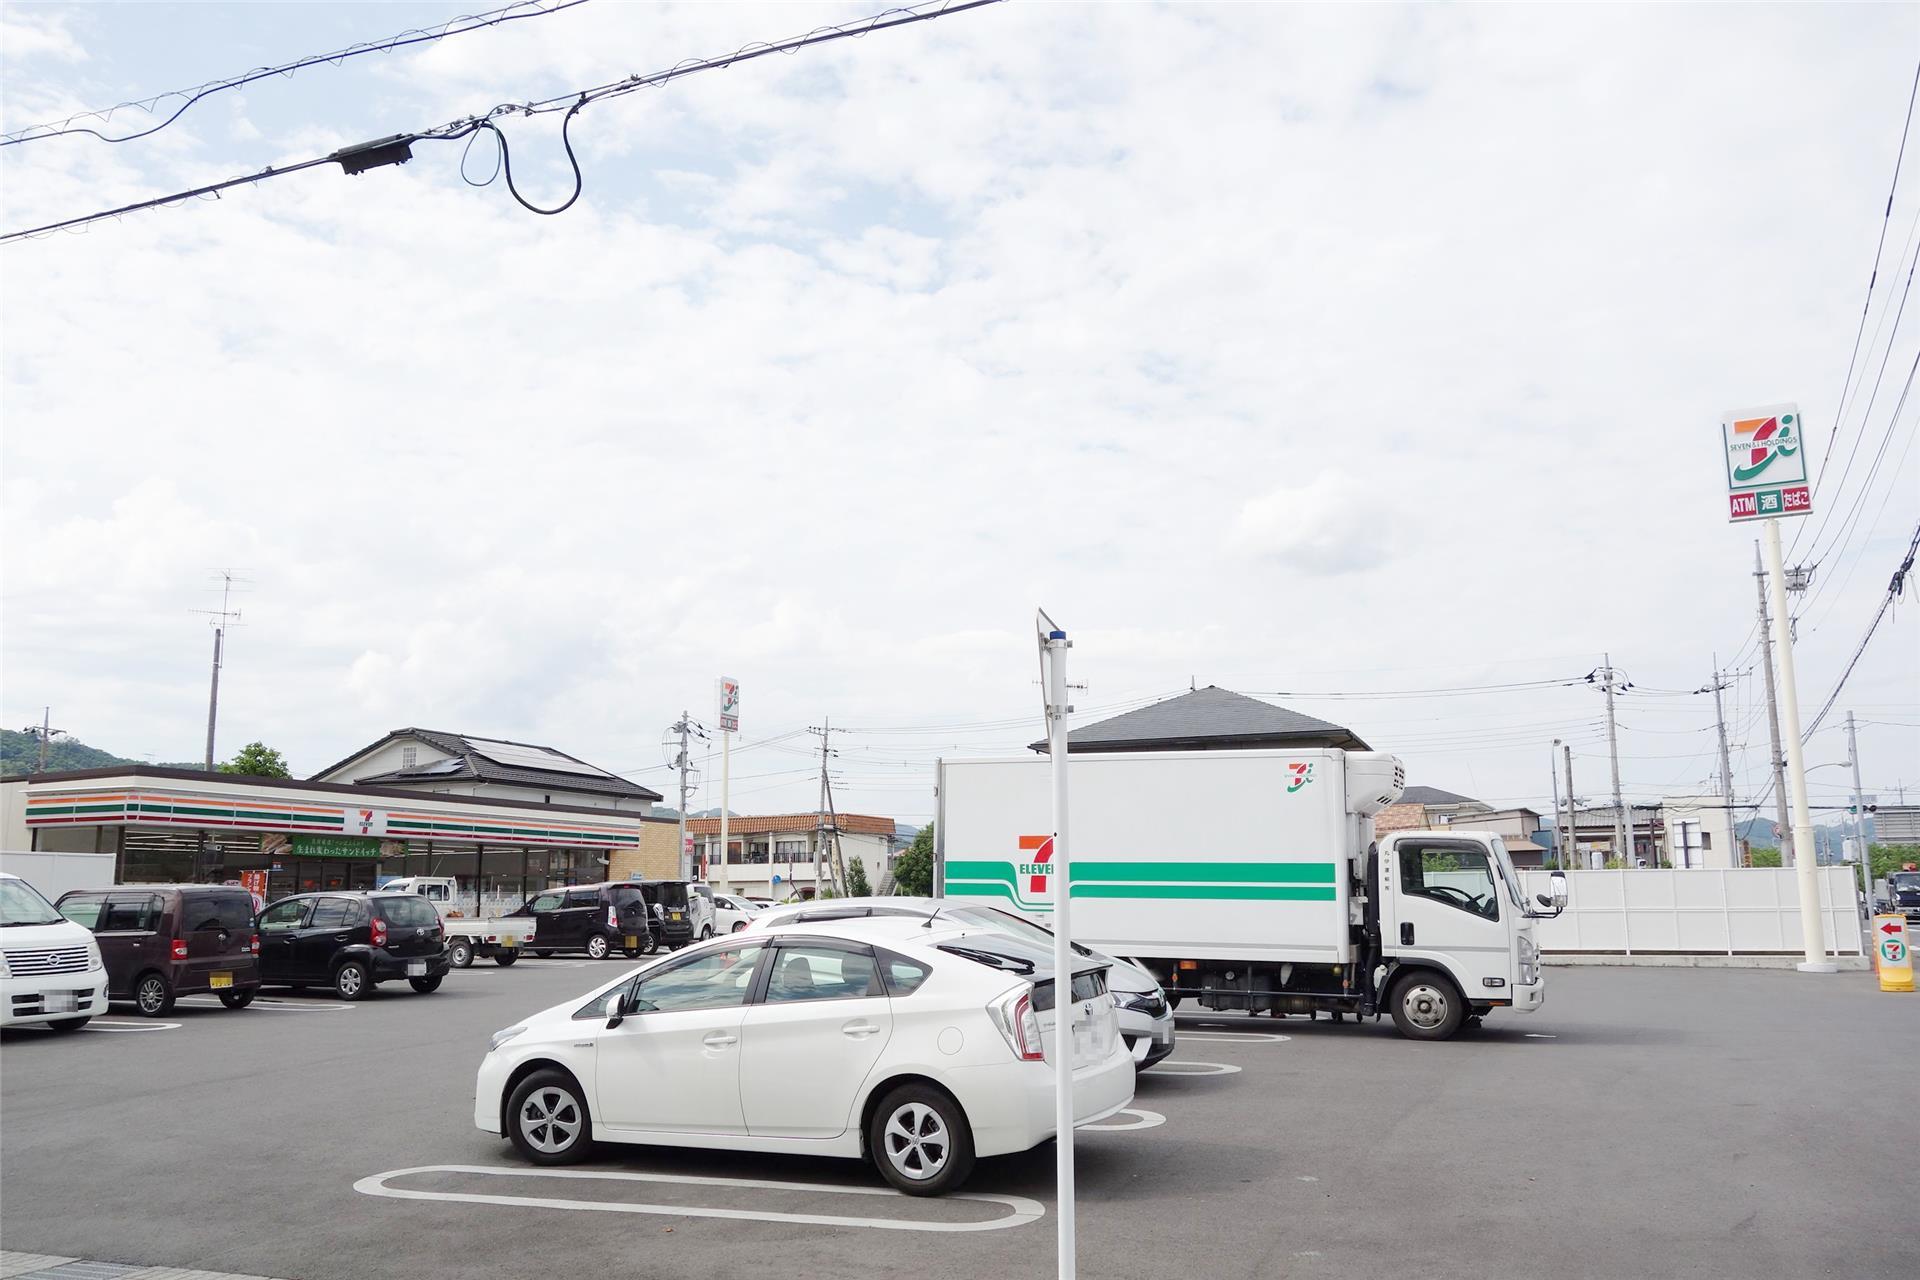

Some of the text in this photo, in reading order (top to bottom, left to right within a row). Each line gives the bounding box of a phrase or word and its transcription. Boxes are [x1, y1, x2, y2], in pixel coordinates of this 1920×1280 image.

[1761, 436, 1798, 447] HOLDINGS
[1732, 497, 1756, 513] ATM
[1761, 494, 1778, 510] 酒
[1783, 491, 1810, 507] たばこ
[1019, 835, 1054, 893] 7
